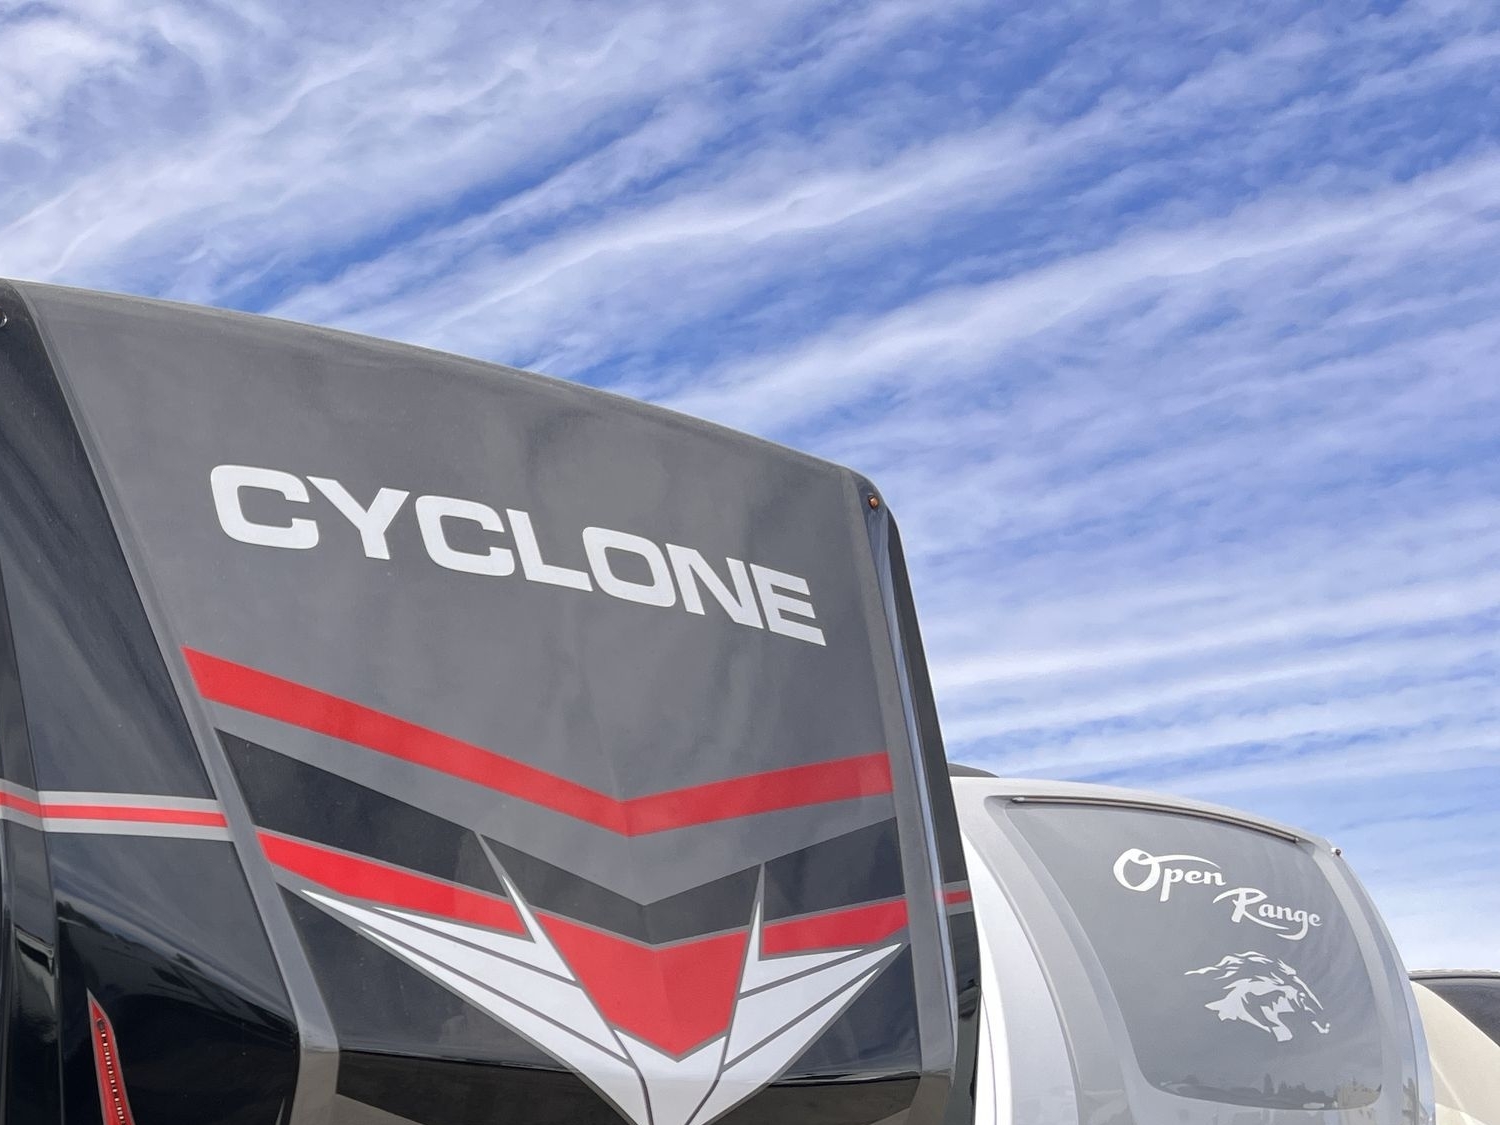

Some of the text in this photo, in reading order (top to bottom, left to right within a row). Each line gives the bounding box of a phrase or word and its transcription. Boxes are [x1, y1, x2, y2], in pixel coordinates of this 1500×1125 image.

[210, 463, 827, 647] CYCLONE
[1113, 848, 1323, 940] Open Range
